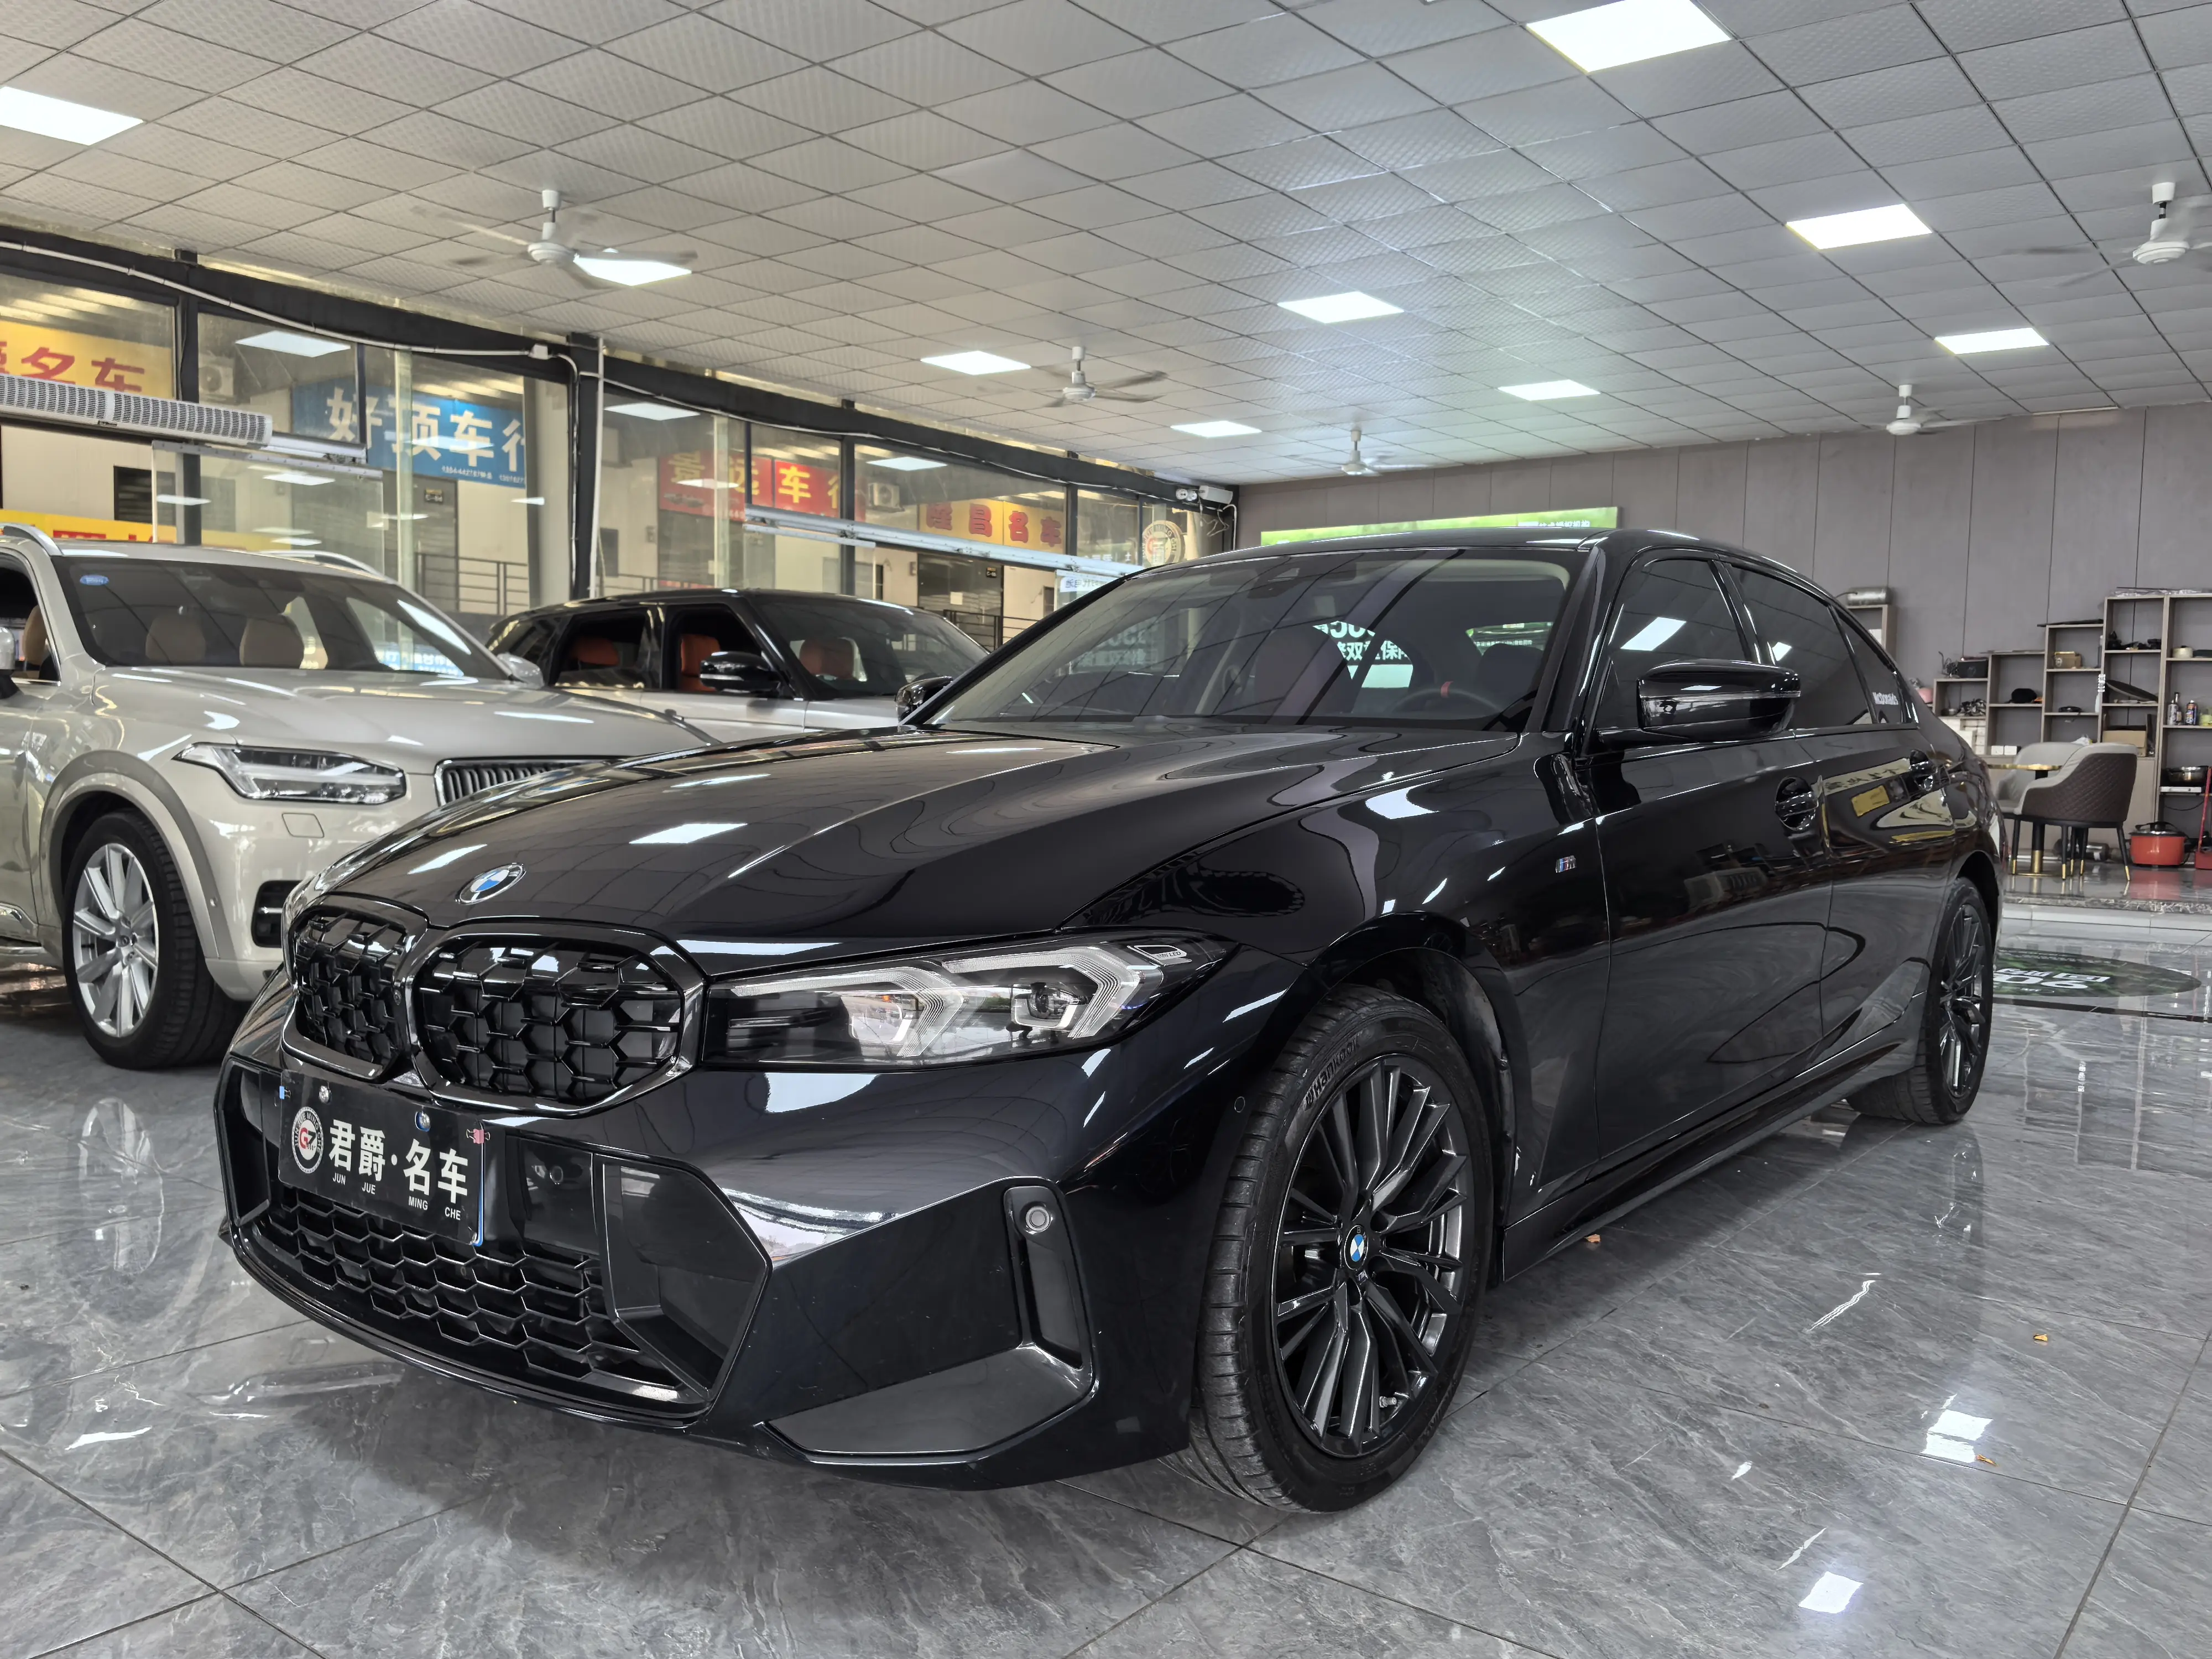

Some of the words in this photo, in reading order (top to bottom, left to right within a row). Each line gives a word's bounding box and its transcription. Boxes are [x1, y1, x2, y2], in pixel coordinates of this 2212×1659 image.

[0, 341, 145, 392] 名车
[306, 1112, 320, 1131] MING
[328, 1118, 469, 1204] 君爵·名车
[332, 1172, 346, 1186] JUN
[362, 1182, 376, 1195] JUE
[408, 1196, 429, 1211] MING
[445, 1207, 461, 1220] CHE
